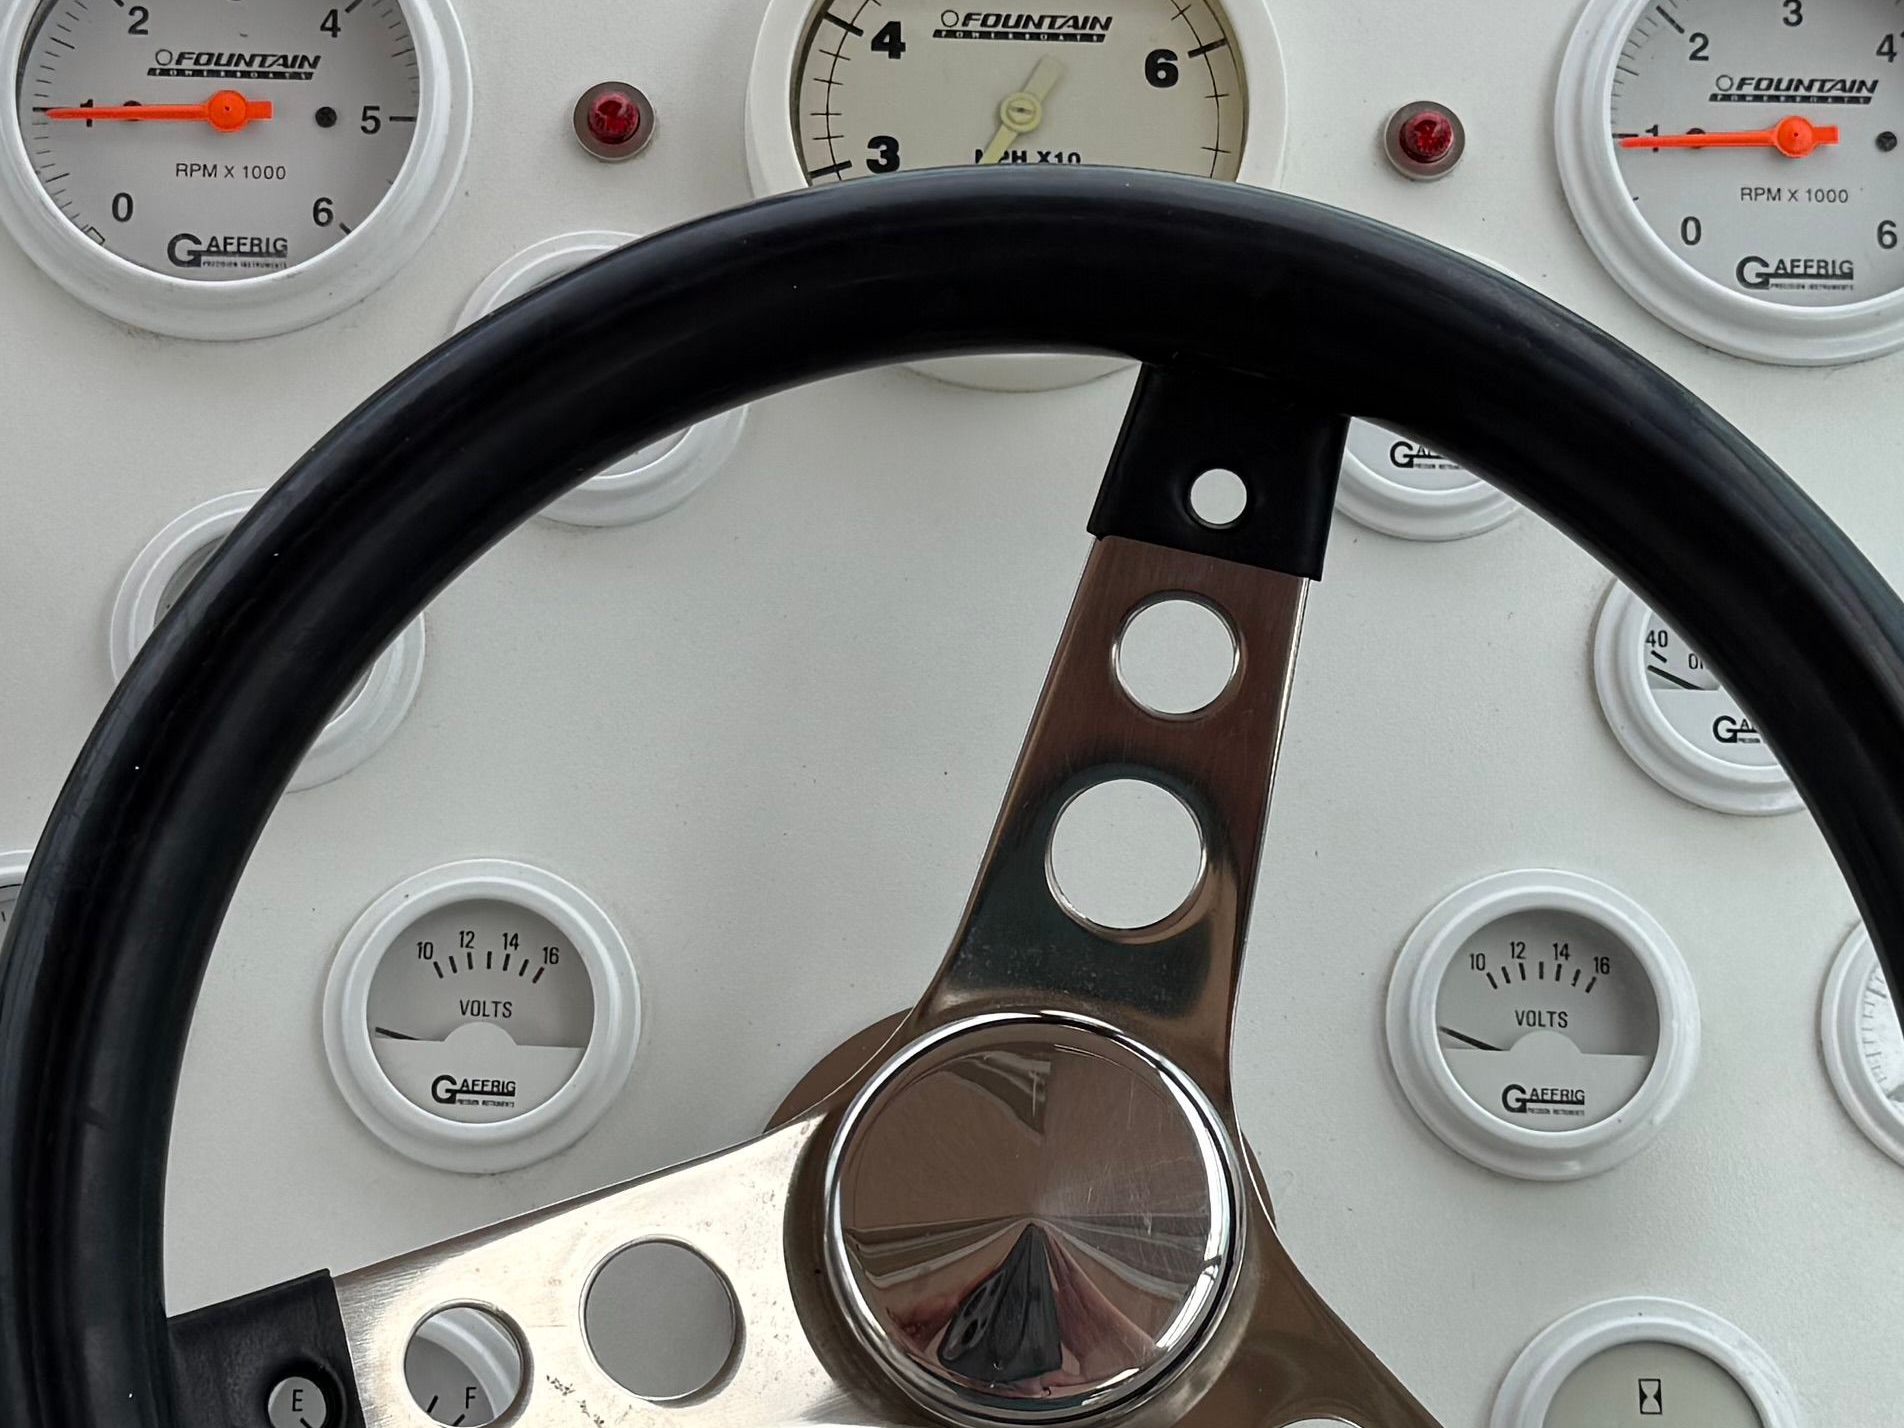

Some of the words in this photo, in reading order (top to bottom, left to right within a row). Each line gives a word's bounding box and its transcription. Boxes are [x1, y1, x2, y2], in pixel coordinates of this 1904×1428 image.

[960, 10, 1113, 33] FOUNTAIN
[174, 50, 323, 72] FOUNTAIN
[1732, 75, 1880, 96] FOUNTAIN
[175, 162, 219, 180] RPM
[223, 164, 235, 179] X
[242, 163, 287, 181] 1000
[1739, 185, 1781, 203] RPM
[1786, 187, 1800, 204] X
[1803, 187, 1850, 205] 1000
[458, 929, 476, 950] 12
[502, 932, 520, 952] 14
[416, 940, 435, 961] 10
[542, 946, 561, 965] 16
[459, 999, 513, 1019] VOLTS
[1514, 1009, 1569, 1029] VOLTS
[291, 1388, 303, 1413] E
[465, 1386, 477, 1409] F
